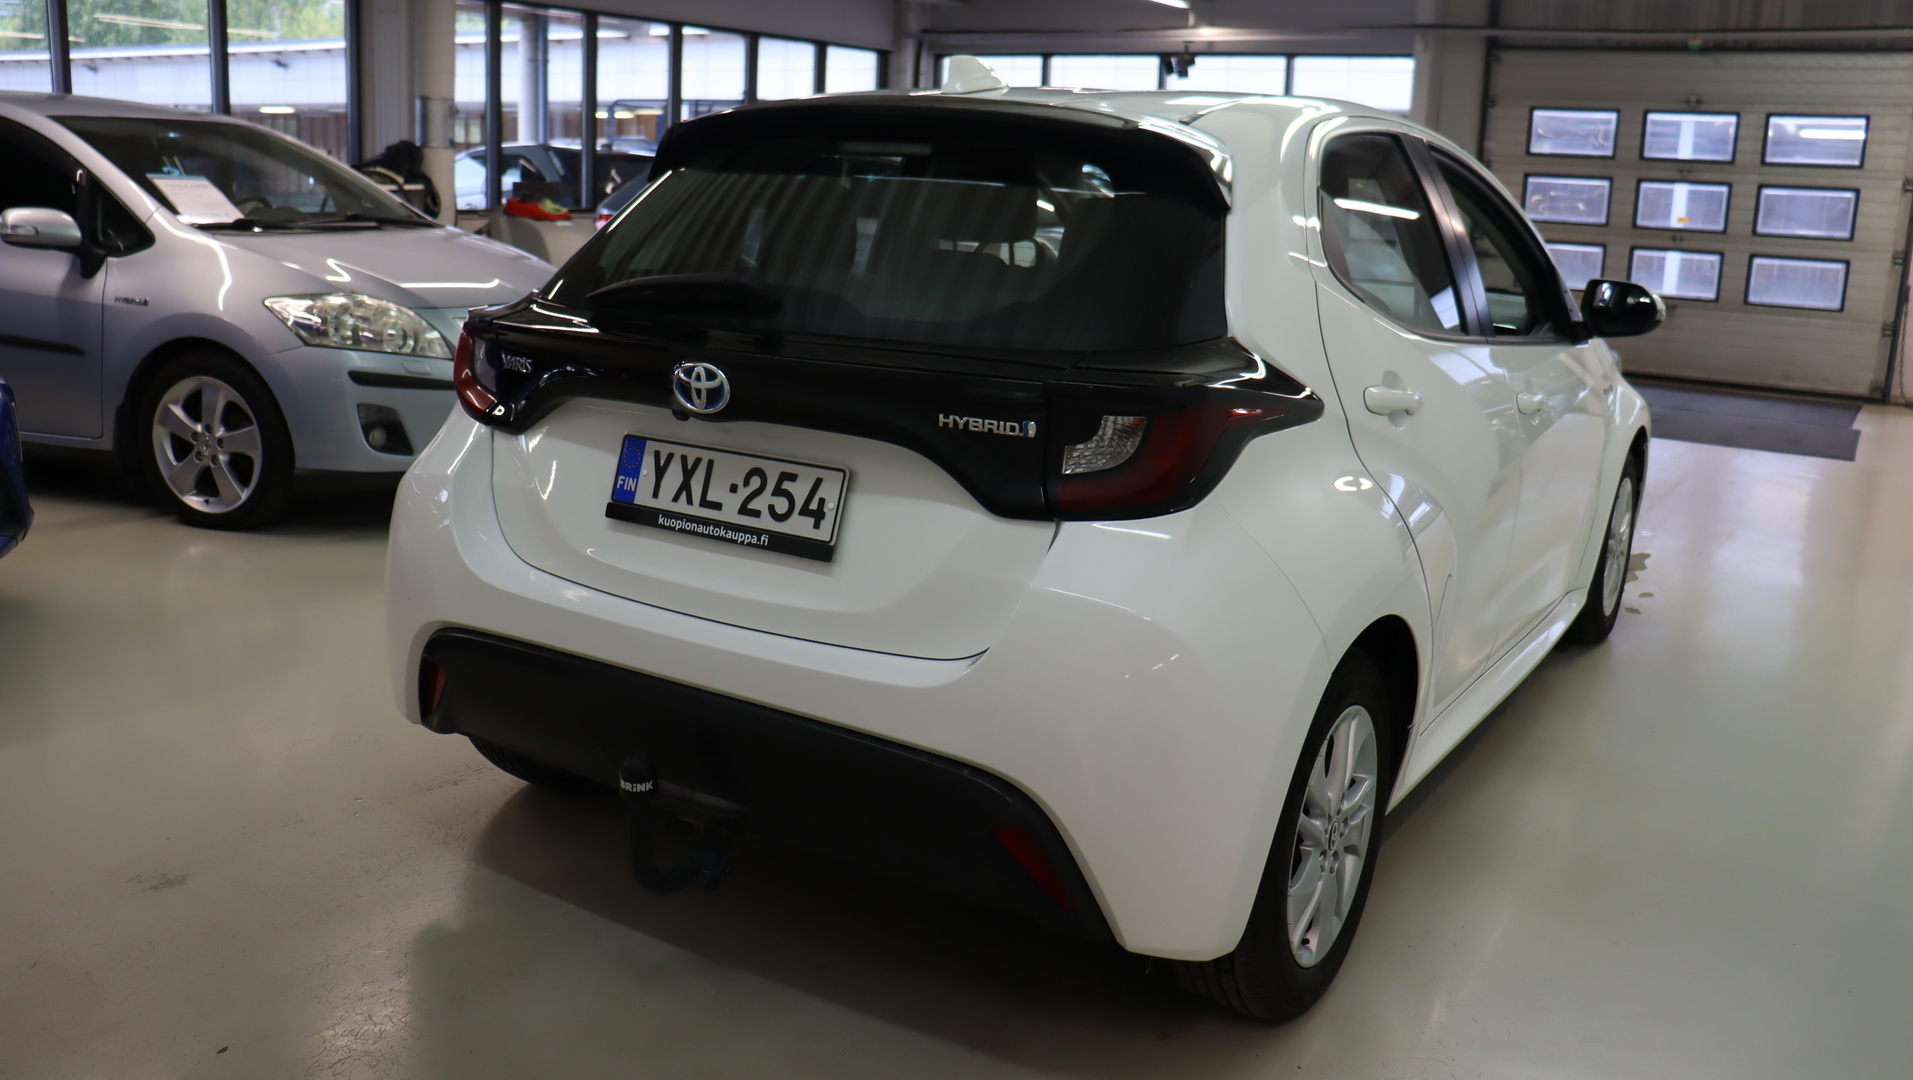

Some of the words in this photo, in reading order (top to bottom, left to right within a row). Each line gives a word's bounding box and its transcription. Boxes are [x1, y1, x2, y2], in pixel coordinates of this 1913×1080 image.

[501, 351, 532, 373] YARIS
[938, 413, 1020, 437] HYBRID
[617, 475, 637, 492] FIN
[658, 514, 769, 547] kuopionautokauppa.fi
